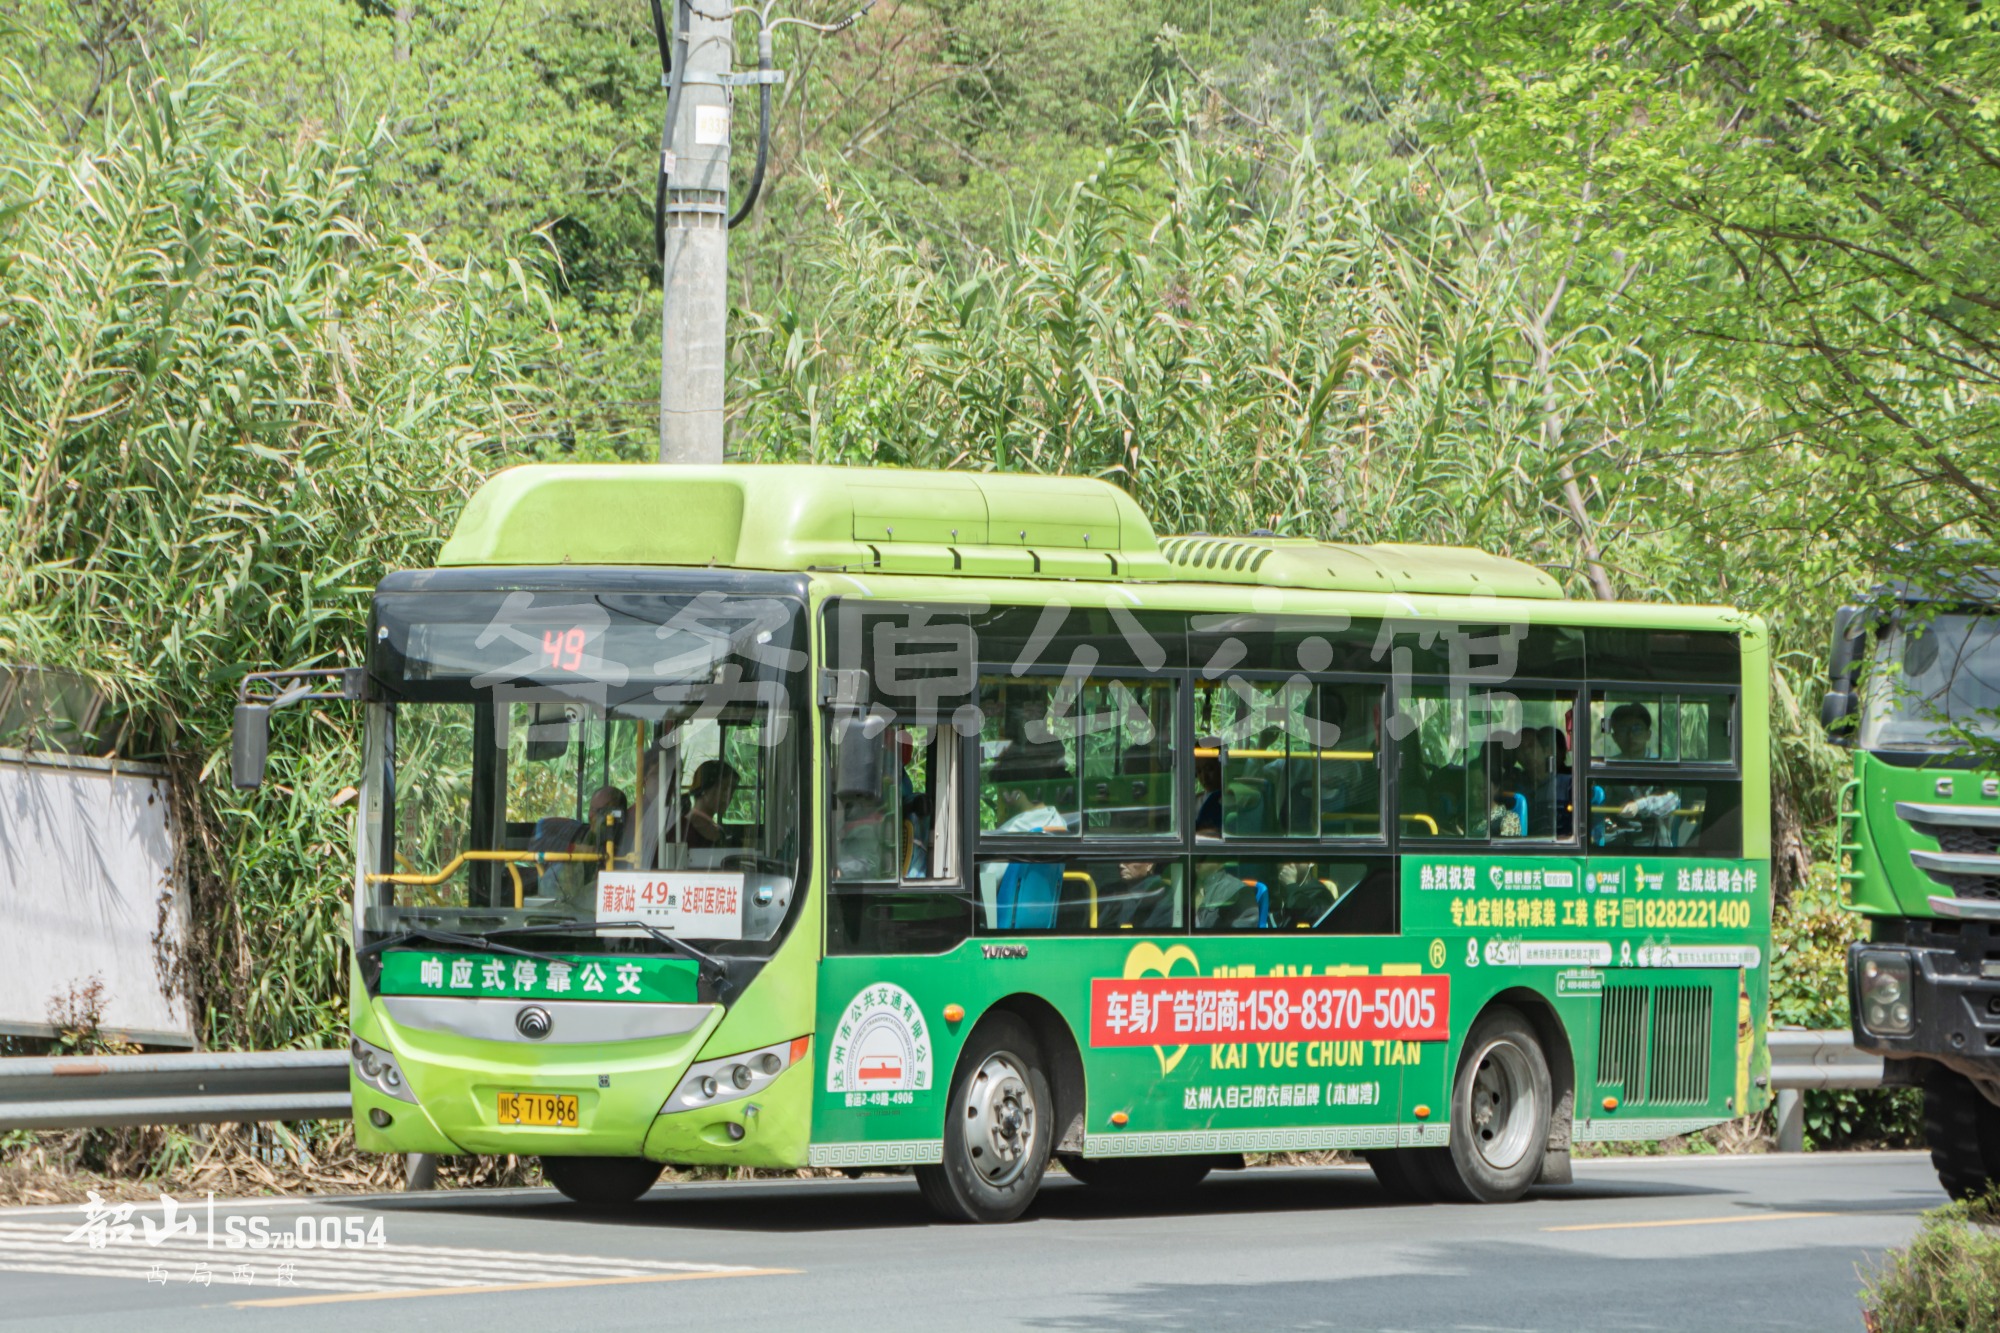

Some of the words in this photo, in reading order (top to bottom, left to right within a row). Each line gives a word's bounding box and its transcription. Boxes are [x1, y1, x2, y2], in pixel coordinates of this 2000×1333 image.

[542, 628, 586, 672] 49
[1420, 865, 1476, 890] 热烈祝贺
[1677, 868, 1757, 893] 达成战略合作
[1450, 897, 1556, 927] 专业定制各种家装
[1562, 898, 1588, 927] 工装
[1635, 899, 1750, 928] 18282221400
[981, 945, 1028, 959] YUTONG
[420, 957, 643, 994] 响应式停靠公交
[833, 988, 927, 1090] 达州市公共交通有限公司
[1210, 1041, 1248, 1069] KAI
[1256, 1041, 1299, 1068] YUE
[1305, 1040, 1364, 1067] CHUN
[1372, 1040, 1421, 1066] TIAN
